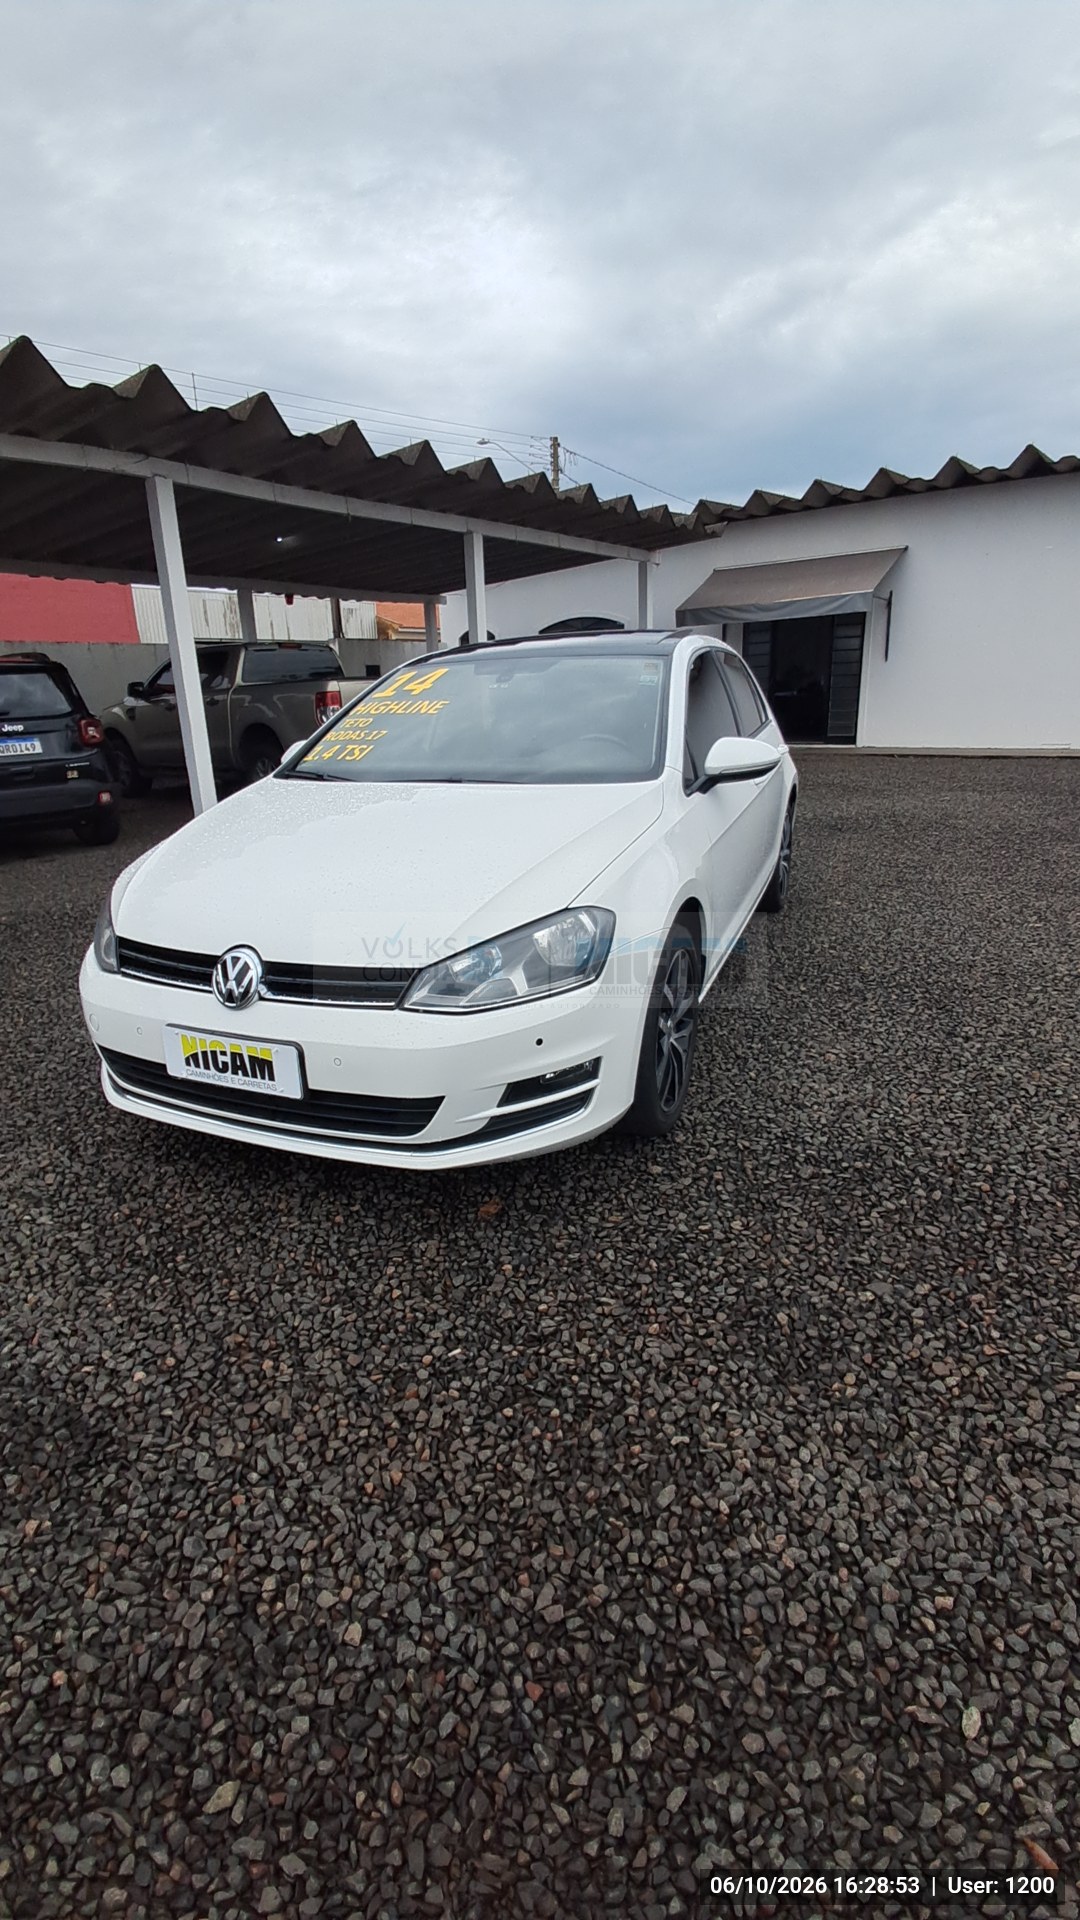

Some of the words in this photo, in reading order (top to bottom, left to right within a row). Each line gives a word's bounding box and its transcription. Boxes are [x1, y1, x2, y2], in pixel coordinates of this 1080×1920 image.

[372, 668, 449, 698] 14
[350, 700, 451, 716] HIGHLINE
[1, 724, 24, 732] Jeep
[340, 717, 374, 728] TETO
[322, 730, 366, 742] RODAS
[365, 730, 389, 741] 17
[303, 745, 342, 762] 1.4
[336, 744, 376, 762] TSI
[181, 1033, 276, 1082] NICAM
[231, 1077, 237, 1085] E
[237, 1078, 278, 1093] CARRETAS
